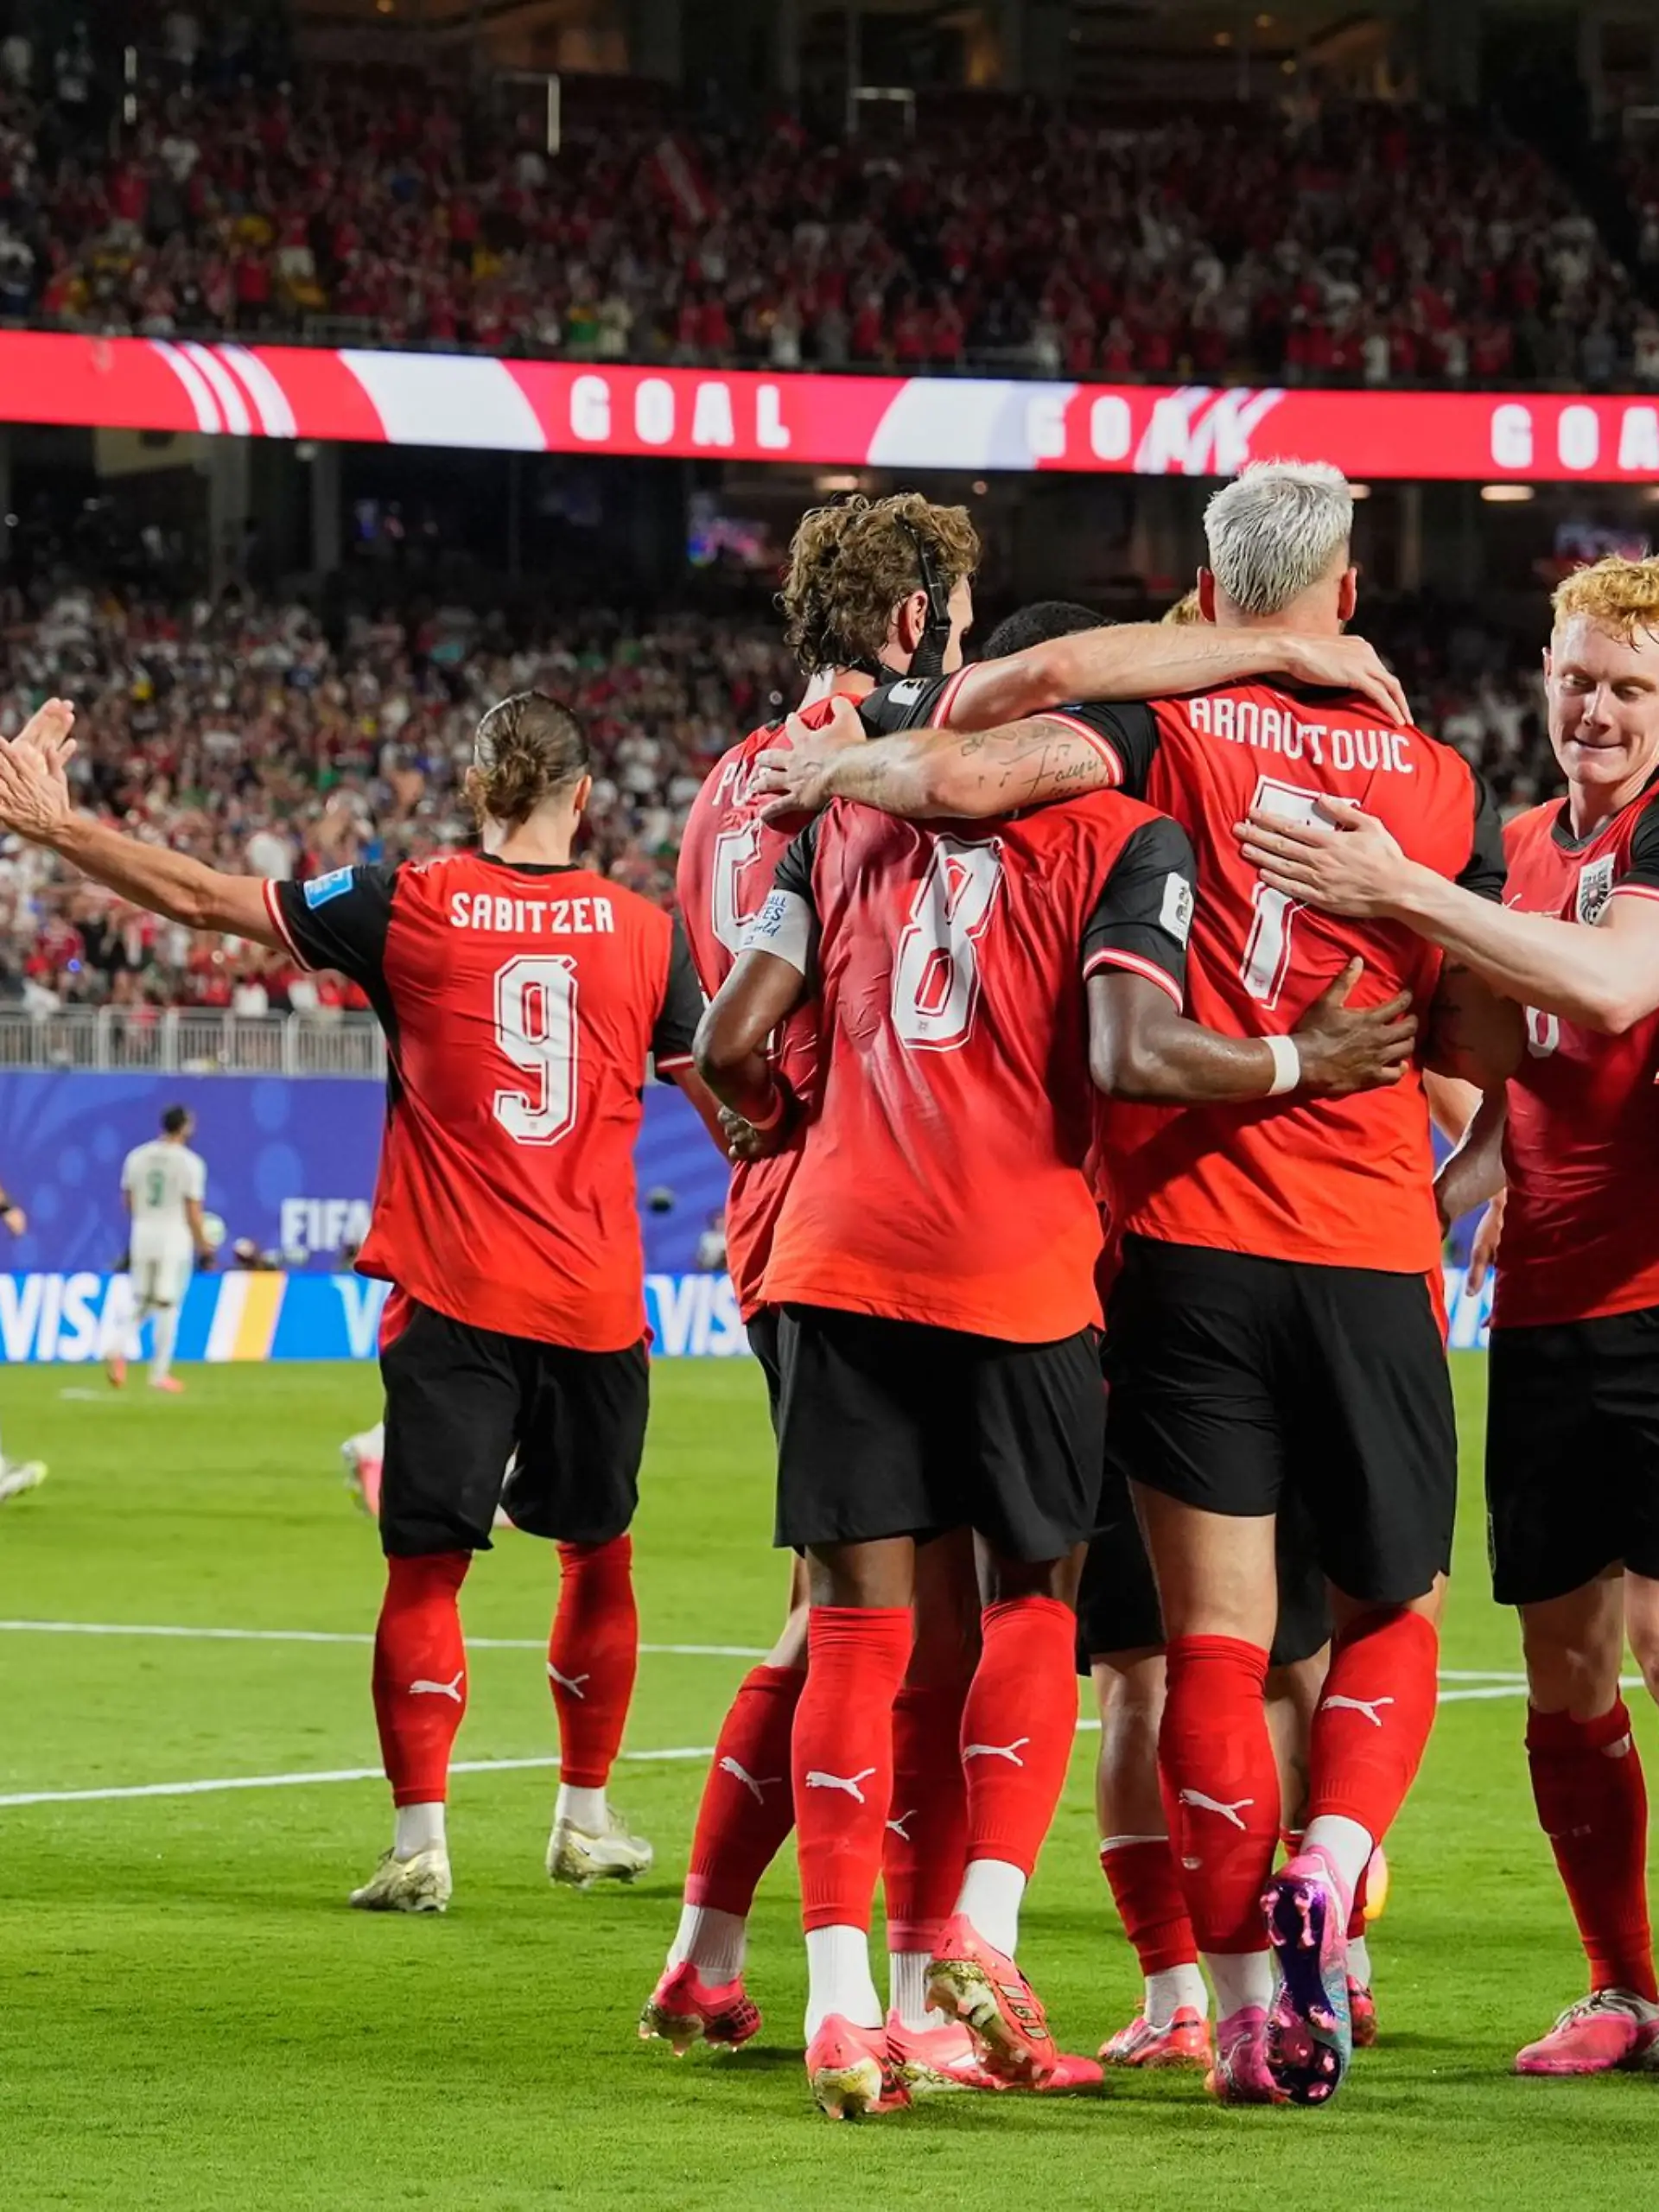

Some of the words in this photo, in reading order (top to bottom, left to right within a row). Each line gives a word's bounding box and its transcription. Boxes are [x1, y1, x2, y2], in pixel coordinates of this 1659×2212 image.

[570, 375, 791, 448] GOAL
[1491, 404, 1658, 470] GOA
[1189, 696, 1414, 774] ARNAUTOVIC
[449, 892, 615, 934] SABITZER
[892, 832, 1007, 1052] 8
[493, 954, 579, 1147] 9
[644, 1274, 751, 1357] VIS
